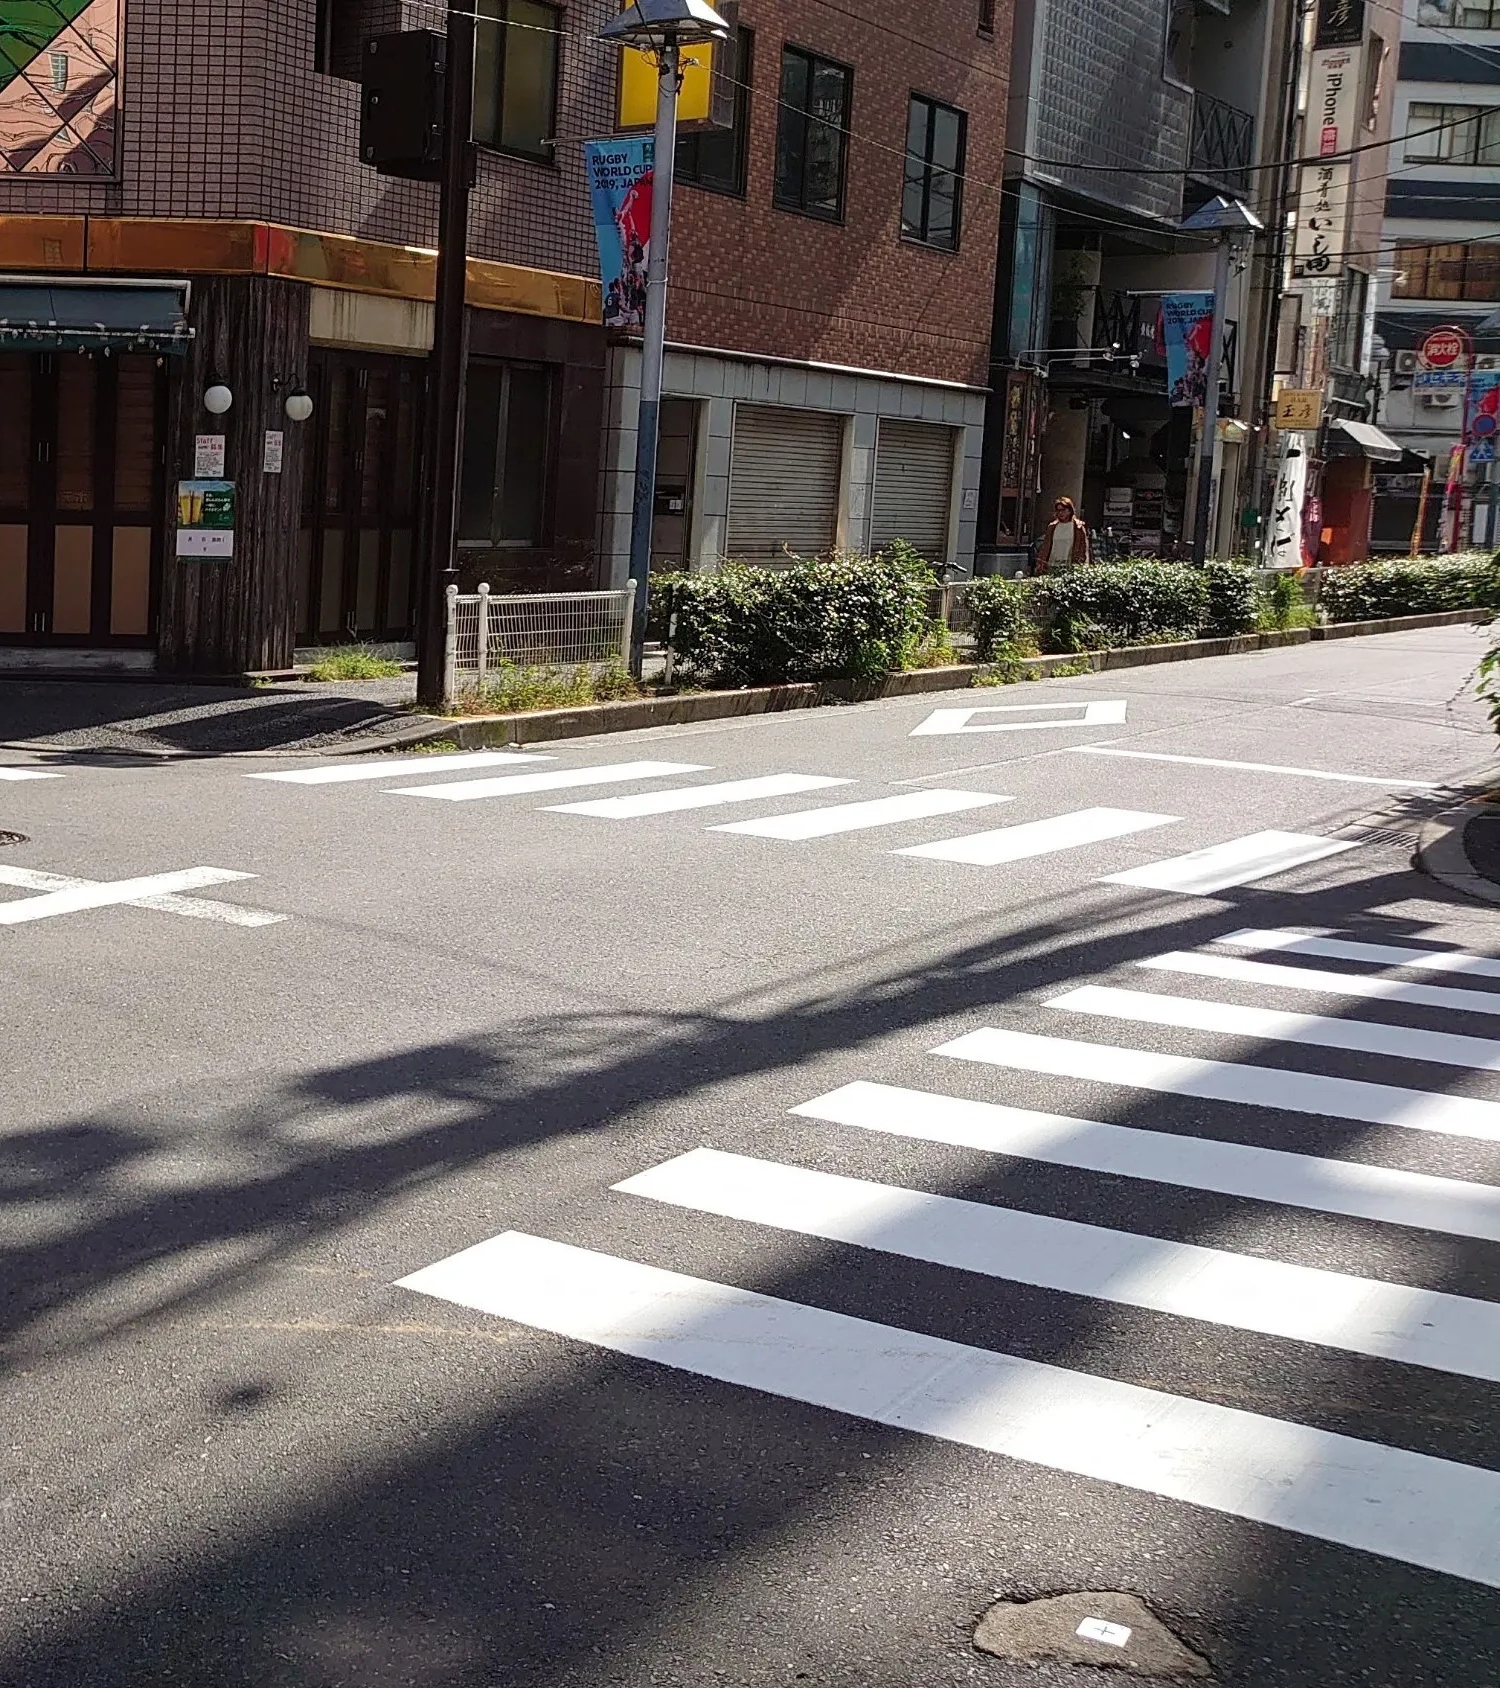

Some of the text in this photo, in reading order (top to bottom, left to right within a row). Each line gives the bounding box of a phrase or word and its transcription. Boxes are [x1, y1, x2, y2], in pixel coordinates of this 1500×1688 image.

[1323, 72, 1344, 126] iPhone
[592, 153, 628, 166] RUGBY
[593, 164, 653, 178] WORLD CUP
[1426, 341, 1459, 357] 消火栓
